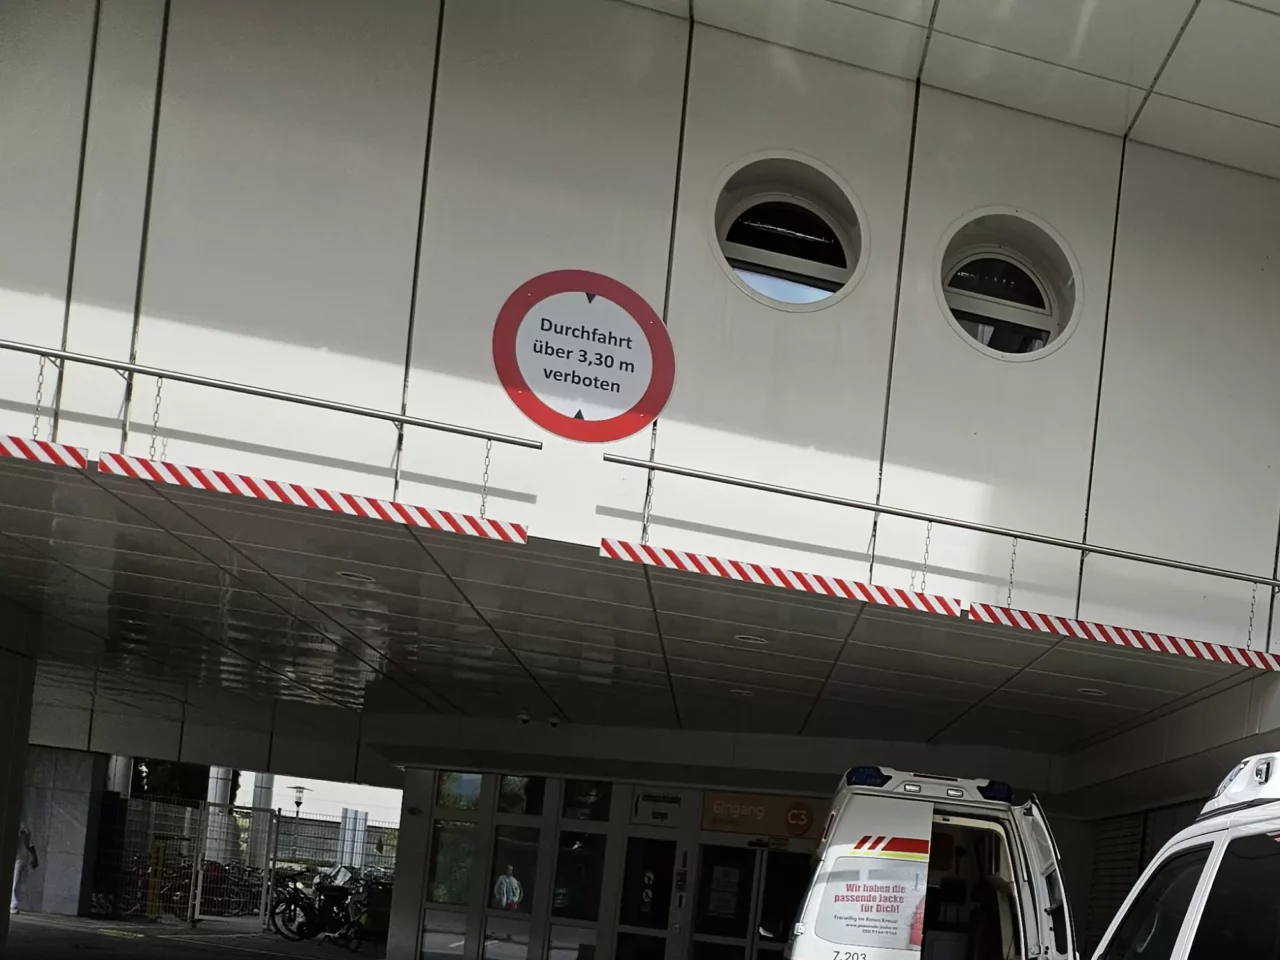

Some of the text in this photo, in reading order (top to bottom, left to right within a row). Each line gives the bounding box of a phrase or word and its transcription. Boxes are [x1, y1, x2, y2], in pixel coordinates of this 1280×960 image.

[540, 317, 633, 350] Durchfahrt
[533, 339, 635, 373] über 3,30 m
[543, 368, 621, 393] verboten
[713, 800, 765, 820] Eingang
[787, 809, 807, 825] C3
[846, 883, 906, 894] Wir haben die
[834, 894, 905, 904] passende Jacke
[861, 904, 900, 913] für Dich!
